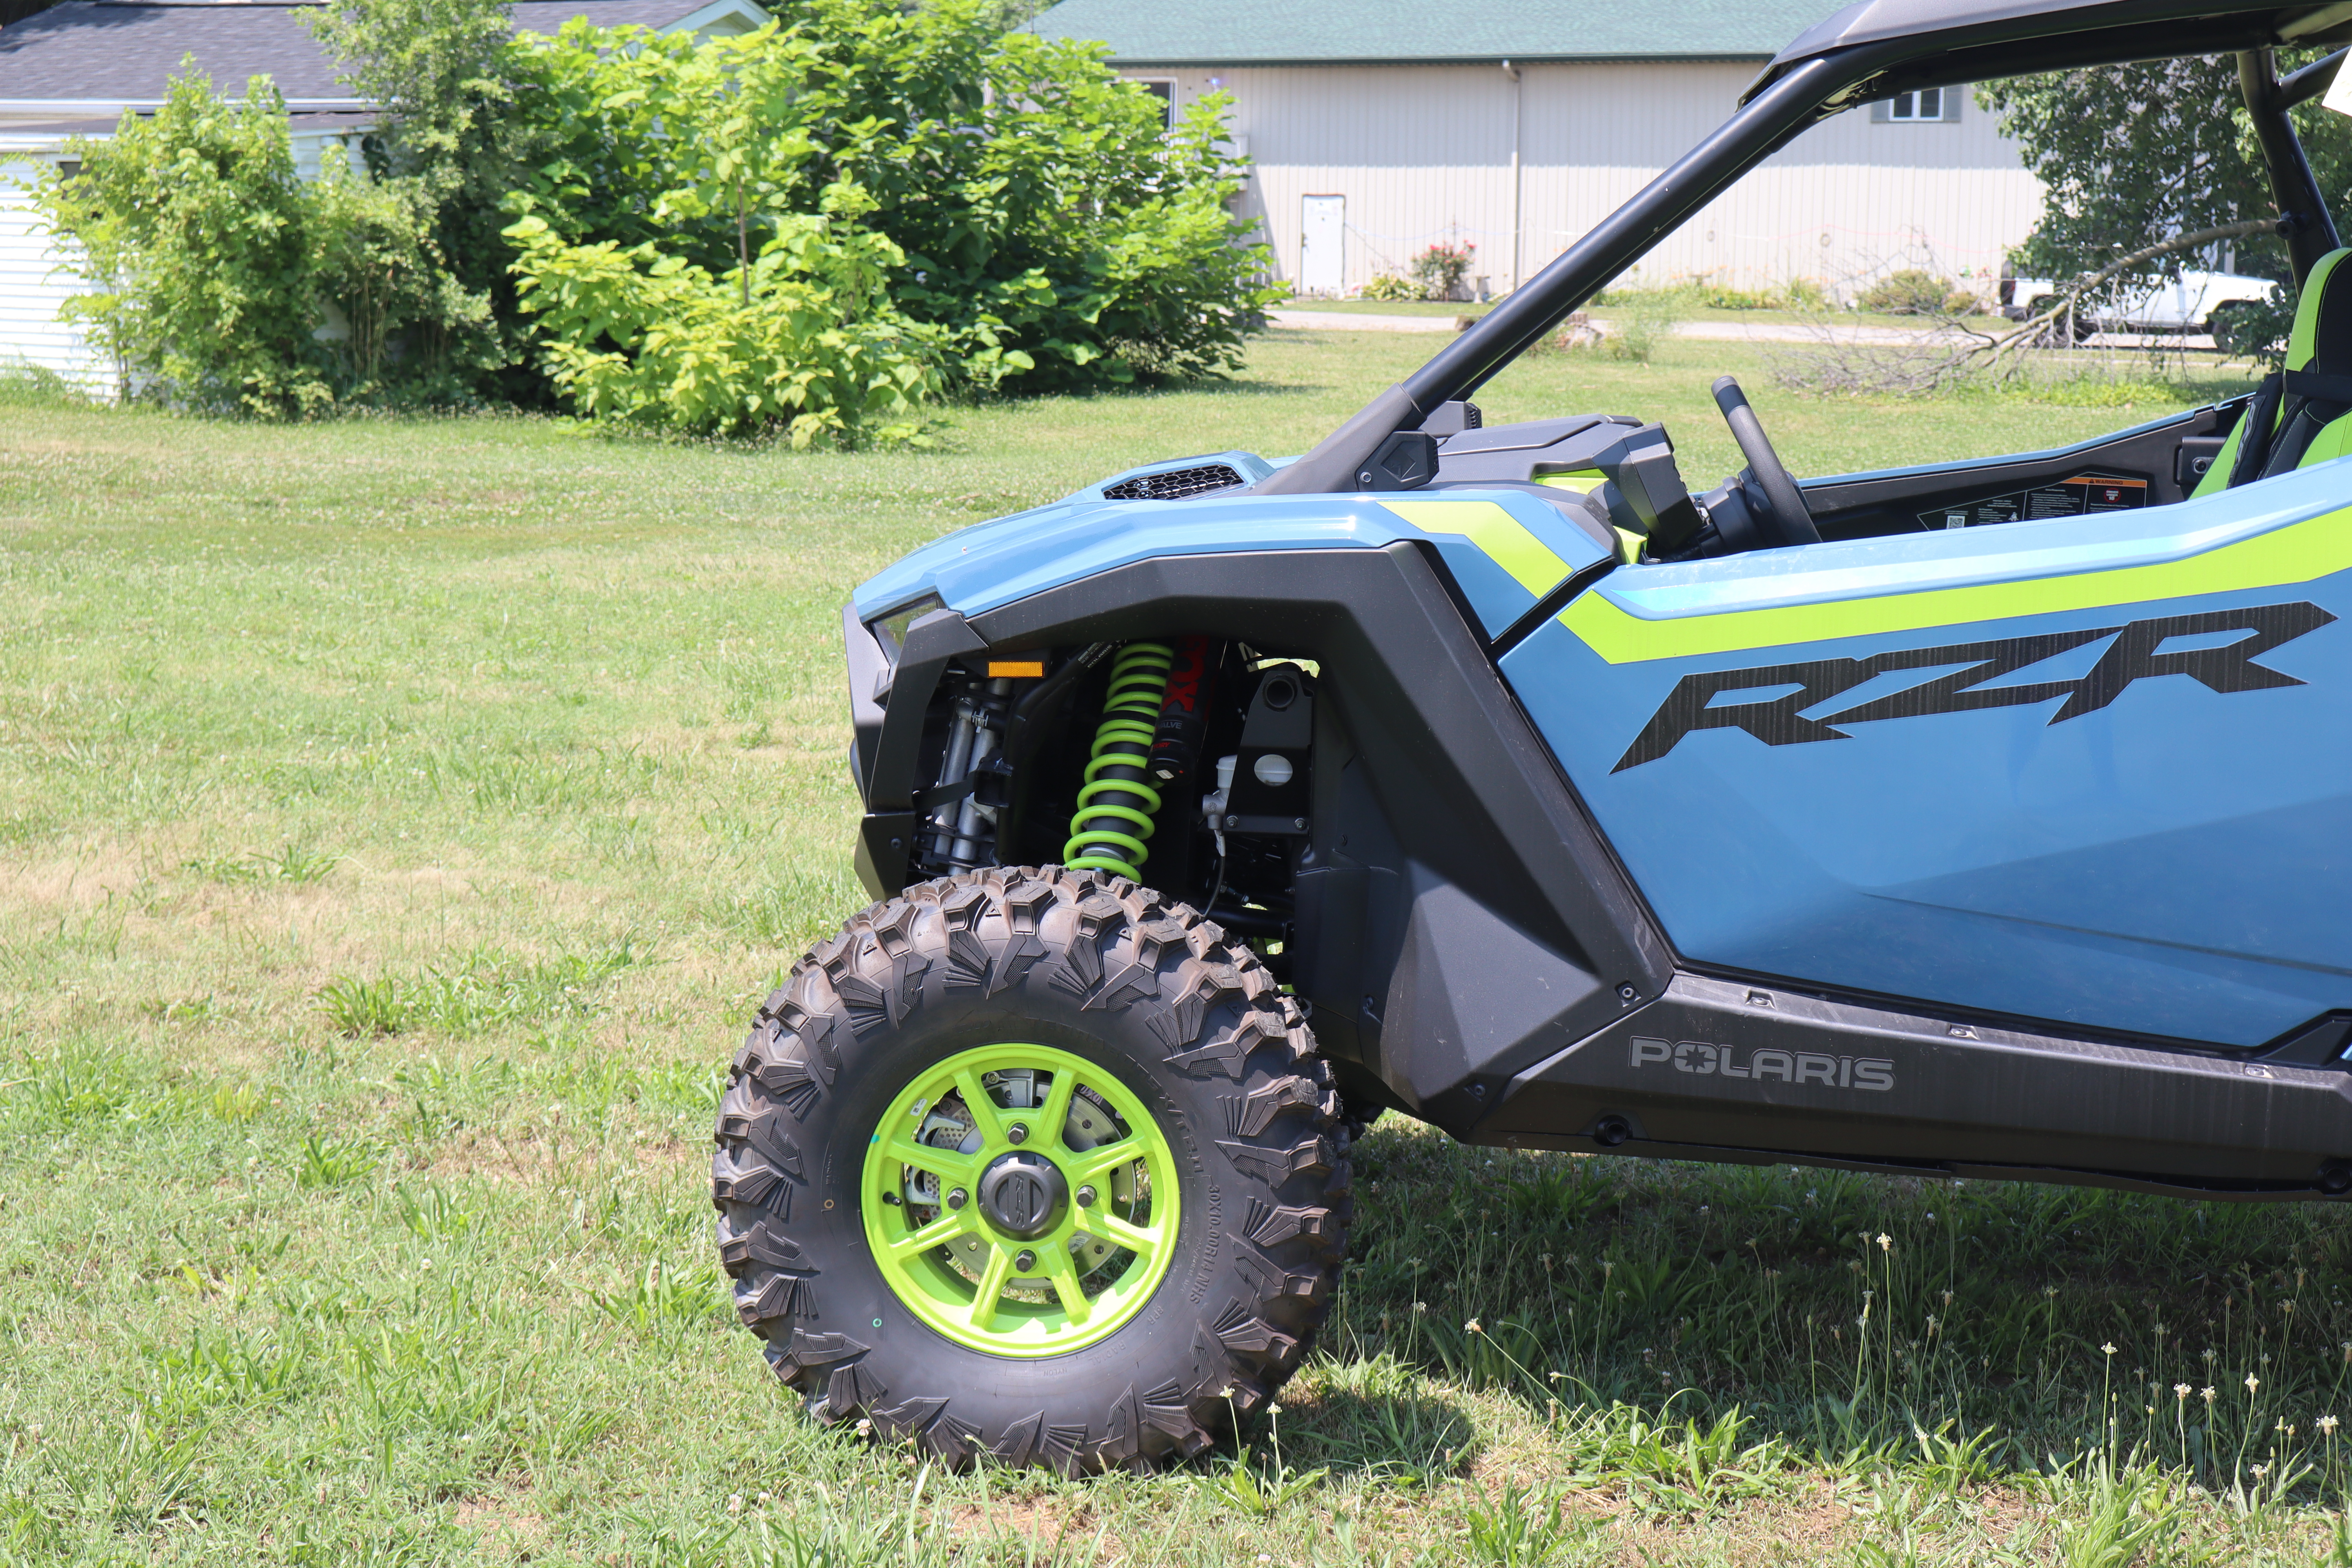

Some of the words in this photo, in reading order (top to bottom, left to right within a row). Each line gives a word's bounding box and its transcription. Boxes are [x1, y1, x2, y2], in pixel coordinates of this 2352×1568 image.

[1087, 644, 1112, 668] POLARIS
[1161, 635, 1209, 712] FOX
[1608, 600, 2339, 775] RZR
[1151, 742, 1171, 750] TORY
[1629, 1036, 1896, 1092] POLARIS
[1201, 1185, 1221, 1272] 30X10.00R14
[1190, 1273, 1210, 1304] NHS
[1147, 1305, 1163, 1326] 8PR
[1088, 1340, 1127, 1366] RADIAL
[1044, 1367, 1067, 1377] NYLON
